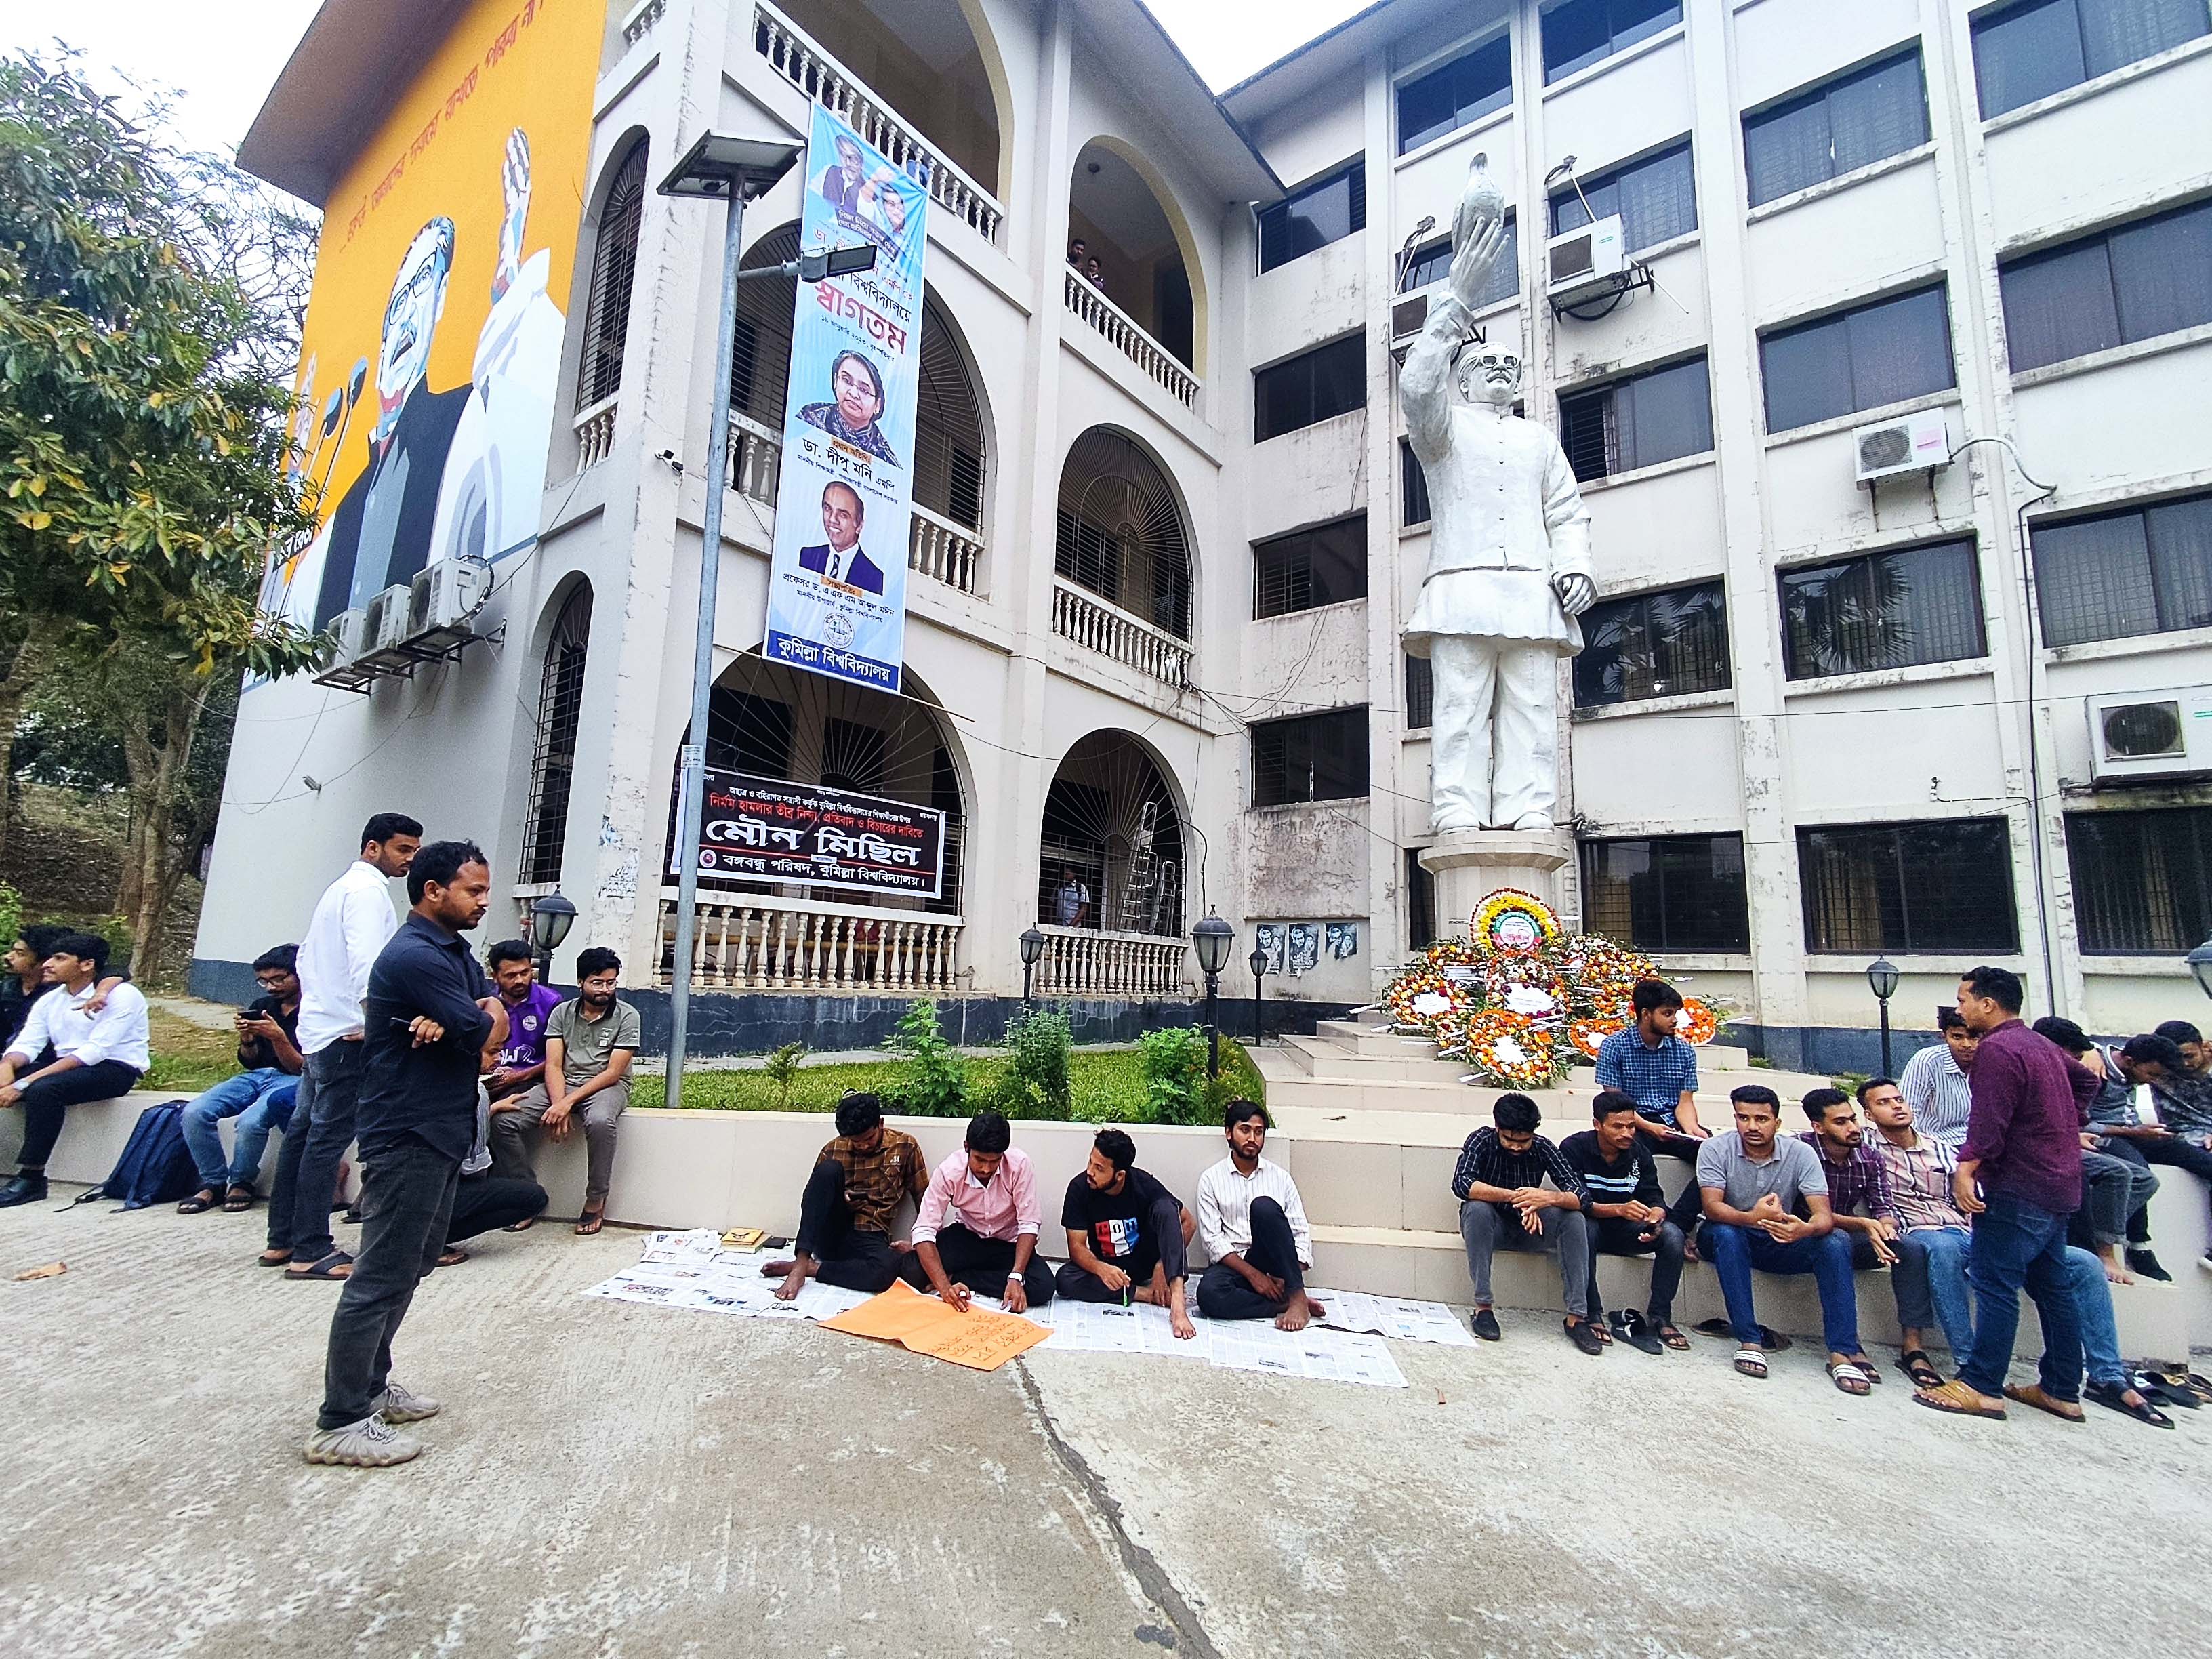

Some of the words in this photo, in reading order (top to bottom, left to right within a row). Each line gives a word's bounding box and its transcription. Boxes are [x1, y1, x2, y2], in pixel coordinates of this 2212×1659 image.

[815, 280, 907, 355] স্বাগতম
[802, 438, 821, 457] ডা.
[826, 446, 849, 474] দীপু
[853, 462, 873, 482] মনি
[875, 478, 895, 492] এমপি
[783, 573, 810, 588] প্রফেসর
[777, 638, 819, 662] কুমিল্লা
[822, 647, 890, 682] বিশ্ববিদ্যালয়
[706, 813, 806, 851] মৌন
[813, 826, 922, 867] মিছিল
[738, 800, 773, 815] হামলার
[823, 811, 855, 827] প্রতিবাদ
[858, 819, 864, 828] ও
[867, 817, 896, 834] বিচারের
[898, 824, 924, 838] দাবিতে
[722, 855, 767, 872] বঙ্গবন্ধু
[771, 859, 815, 876] পরিষদ,
[819, 863, 855, 880] কুমিল্লা
